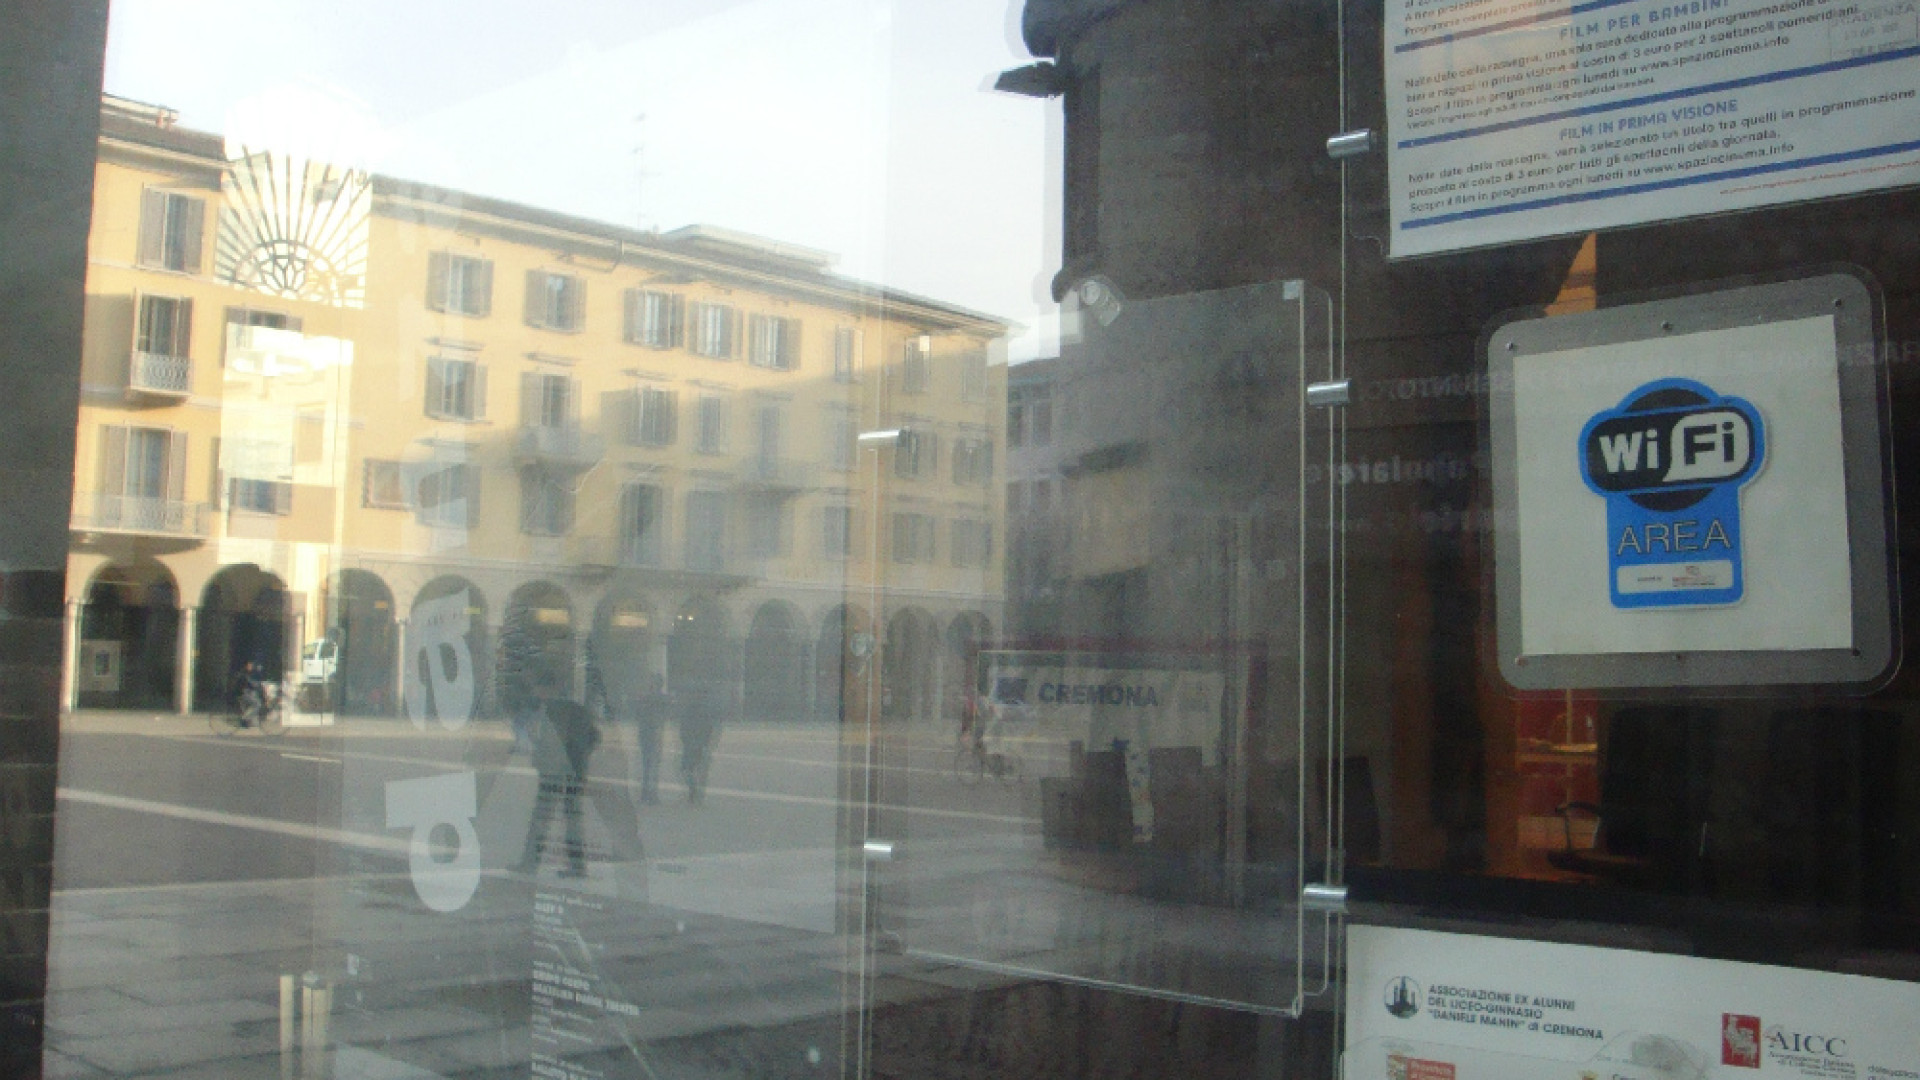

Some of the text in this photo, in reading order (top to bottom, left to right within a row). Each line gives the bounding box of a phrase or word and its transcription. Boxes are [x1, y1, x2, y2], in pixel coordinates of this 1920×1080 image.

[1558, 22, 1598, 40] FILM
[1607, 13, 1640, 31] PER
[1643, 43, 1670, 55] euro
[1559, 98, 1738, 141] FILM IN PRIMA VISIONE
[1718, 120, 1736, 130] tra
[1740, 111, 1776, 129] quelli
[1798, 89, 1916, 119] programmazione
[1617, 519, 1733, 557] AREA
[1038, 681, 1160, 707] CREMONA
[1428, 984, 1576, 1011] ASSOCIAZIONE EX ALUNNI
[1428, 996, 1543, 1019] DEL LICEO-GINNASIO
[1528, 1022, 1539, 1031] di
[1543, 1023, 1604, 1040] CREMONA
[1766, 1031, 1847, 1057] AICC
